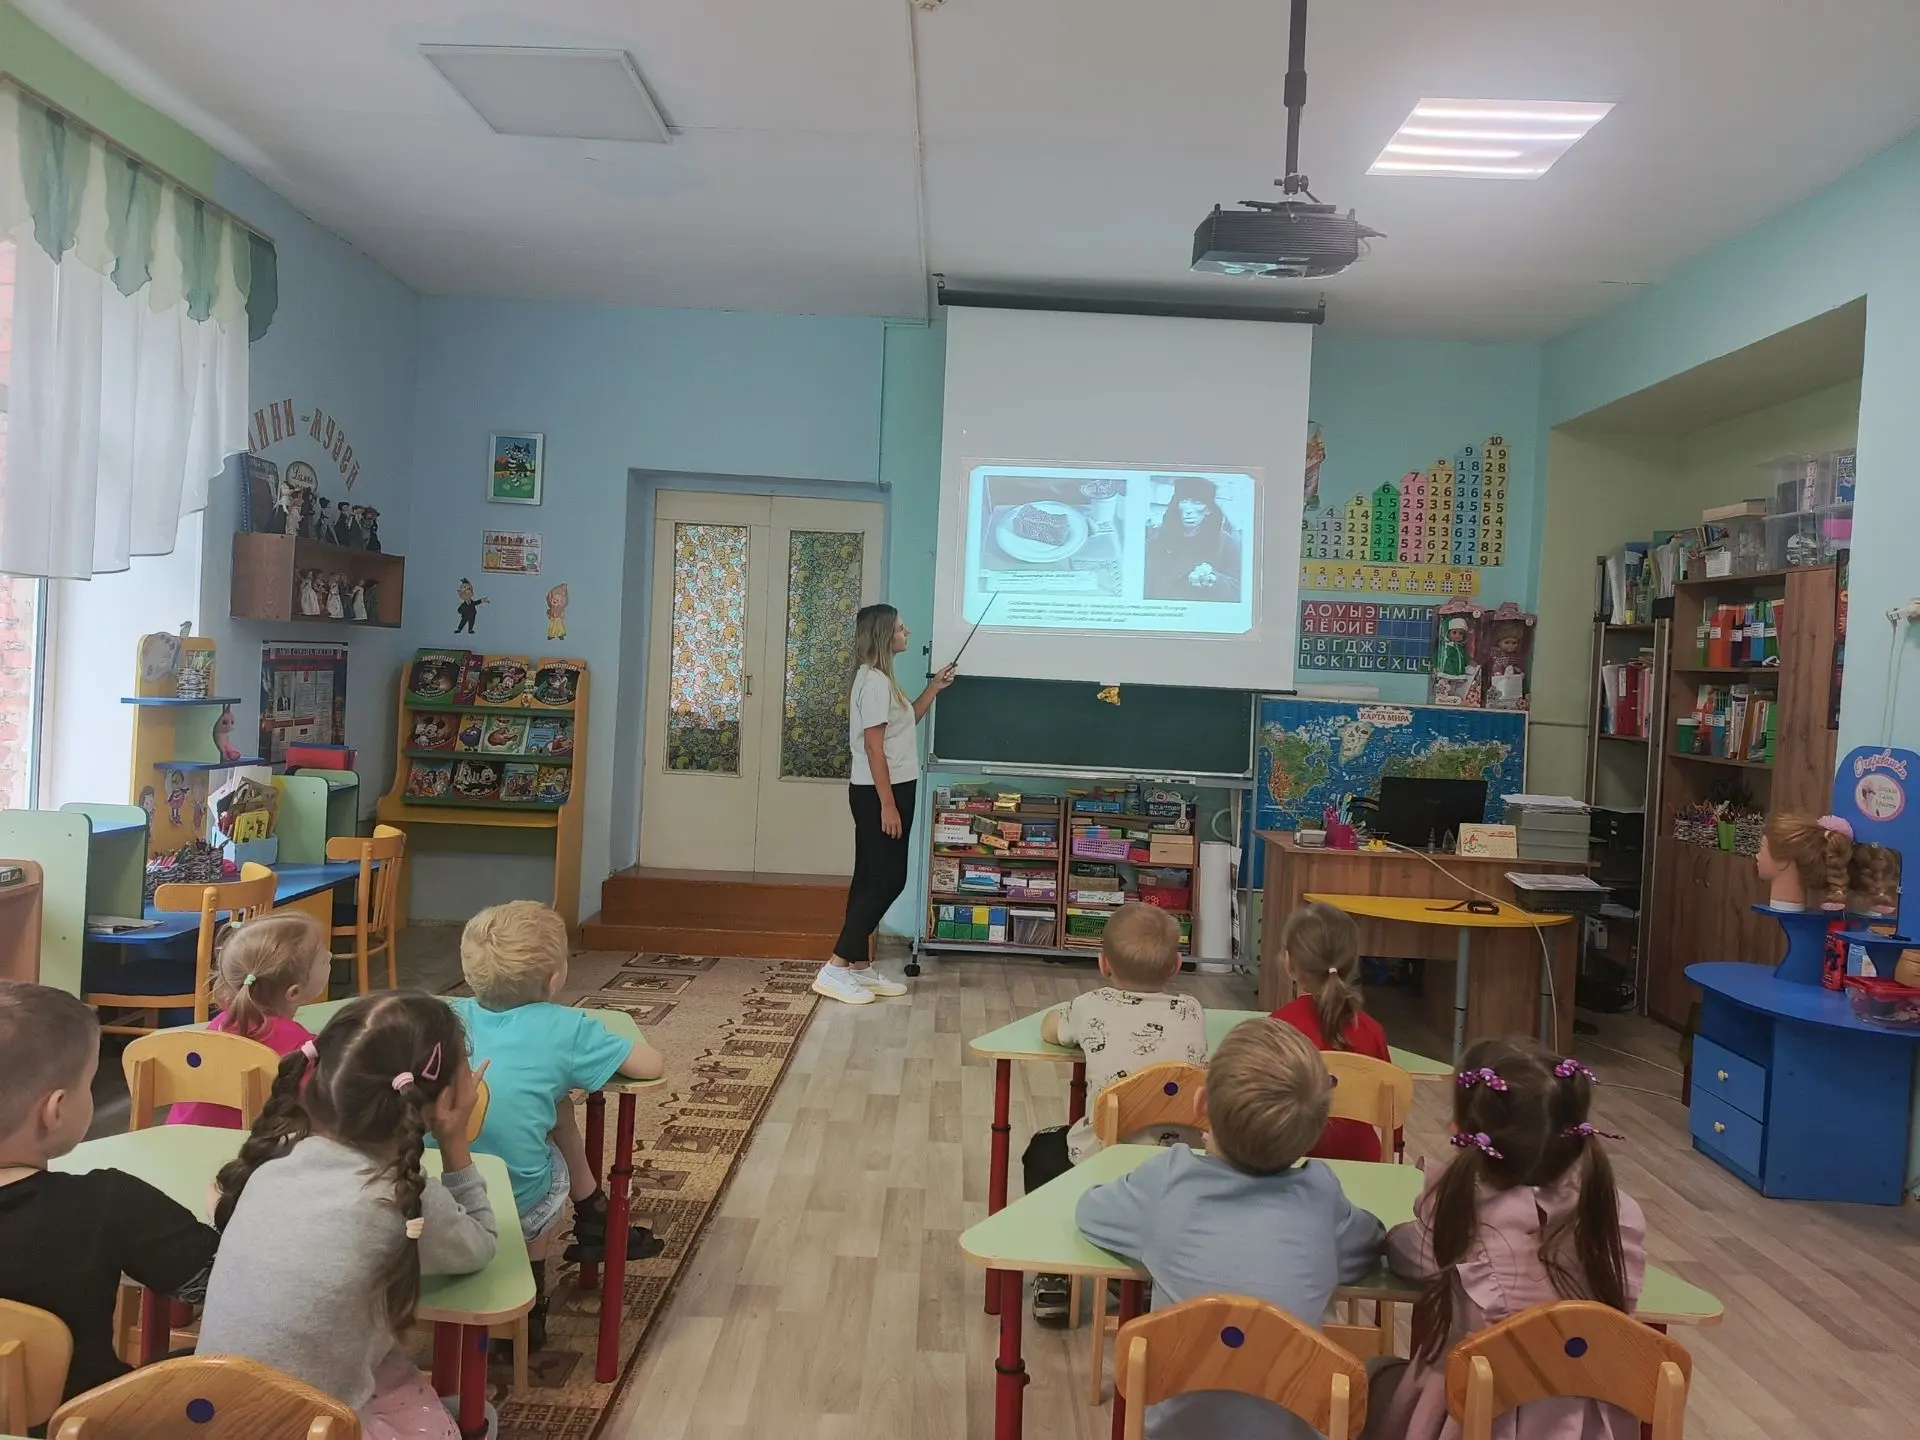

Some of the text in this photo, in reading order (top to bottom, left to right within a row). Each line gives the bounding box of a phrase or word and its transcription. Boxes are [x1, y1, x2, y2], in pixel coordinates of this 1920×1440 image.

[1490, 436, 1503, 446] 10
[1465, 447, 1473, 456] 9
[1486, 449, 1506, 460] 1 9
[1459, 460, 1479, 471] 1 8
[1485, 462, 1506, 472] 2 8
[1411, 472, 1419, 482] 7
[1432, 473, 1452, 483] 1 7
[1458, 474, 1479, 484] 2 7
[1485, 476, 1505, 486] 3 7
[1382, 484, 1390, 494] 6
[1404, 485, 1424, 495] 1 6
[1431, 486, 1452, 496] 2 6
[1457, 487, 1478, 498] 3 6
[1484, 489, 1504, 500] 4 6
[1356, 496, 1363, 506] 5
[1376, 498, 1397, 508] 1 5
[1403, 498, 1424, 509] 2 5
[1430, 500, 1451, 510] 3 5
[1456, 501, 1478, 511] 4 5
[1483, 502, 1504, 513] 5 5
[1326, 508, 1334, 518] 4
[1349, 509, 1370, 520] 1 4
[1375, 511, 1396, 521] 2 4
[1402, 512, 1423, 522] 3 4
[1429, 513, 1450, 524] 4 4
[1456, 514, 1477, 525] 5 4
[1482, 516, 1503, 526] 6 4
[1301, 519, 1309, 530] 3
[1321, 521, 1342, 531] 1 3
[1348, 522, 1368, 533] 2 3
[1374, 524, 1396, 534] 3 3
[1401, 526, 1422, 536] 4 3
[1428, 526, 1449, 536] 5 3
[1455, 528, 1476, 538] 6 3
[1482, 529, 1502, 539] 7 3
[1307, 534, 1314, 544] 2
[1321, 534, 1341, 545] 2 2
[1347, 536, 1368, 546] 3 2
[1374, 538, 1395, 548] 4 2
[1401, 539, 1422, 549] 5 2
[1428, 540, 1448, 550] 6 2
[1454, 541, 1475, 551] 7 2
[1481, 542, 1502, 552] 8 2
[1306, 547, 1313, 558] 1
[1319, 548, 1340, 559] 3 1
[1345, 549, 1366, 560] 4 1
[1373, 551, 1393, 561] 5 1
[1400, 552, 1420, 563] 6 1
[1427, 553, 1447, 564] 7 1
[1453, 554, 1474, 565] 8 1
[1480, 556, 1500, 567] 9 1
[1302, 566, 1307, 574] 1
[1374, 569, 1380, 577] 5
[1391, 570, 1397, 578] 6
[1410, 571, 1416, 579] 7
[1445, 573, 1451, 581] 9
[1459, 573, 1471, 581] 10
[1304, 604, 1316, 616] А
[1319, 604, 1332, 616] О
[1336, 604, 1346, 617] У
[1349, 605, 1361, 618] Ы
[1365, 606, 1375, 618] Э
[1379, 607, 1389, 619] Н
[1393, 607, 1406, 620] М
[1409, 608, 1419, 620] Л
[1304, 618, 1374, 634] Я Ё Ю И Е
[1302, 638, 1386, 654] Б В Г Д Ж З
[1300, 654, 1310, 666] П
[1314, 654, 1326, 666] Ф
[1331, 655, 1341, 667] К
[1347, 656, 1356, 668] Т
[1360, 656, 1373, 668] Ш
[1376, 657, 1386, 669] С
[1391, 658, 1402, 669] Х
[1406, 658, 1417, 671] Ц
[1360, 713, 1410, 722] КАРТА МИРА
